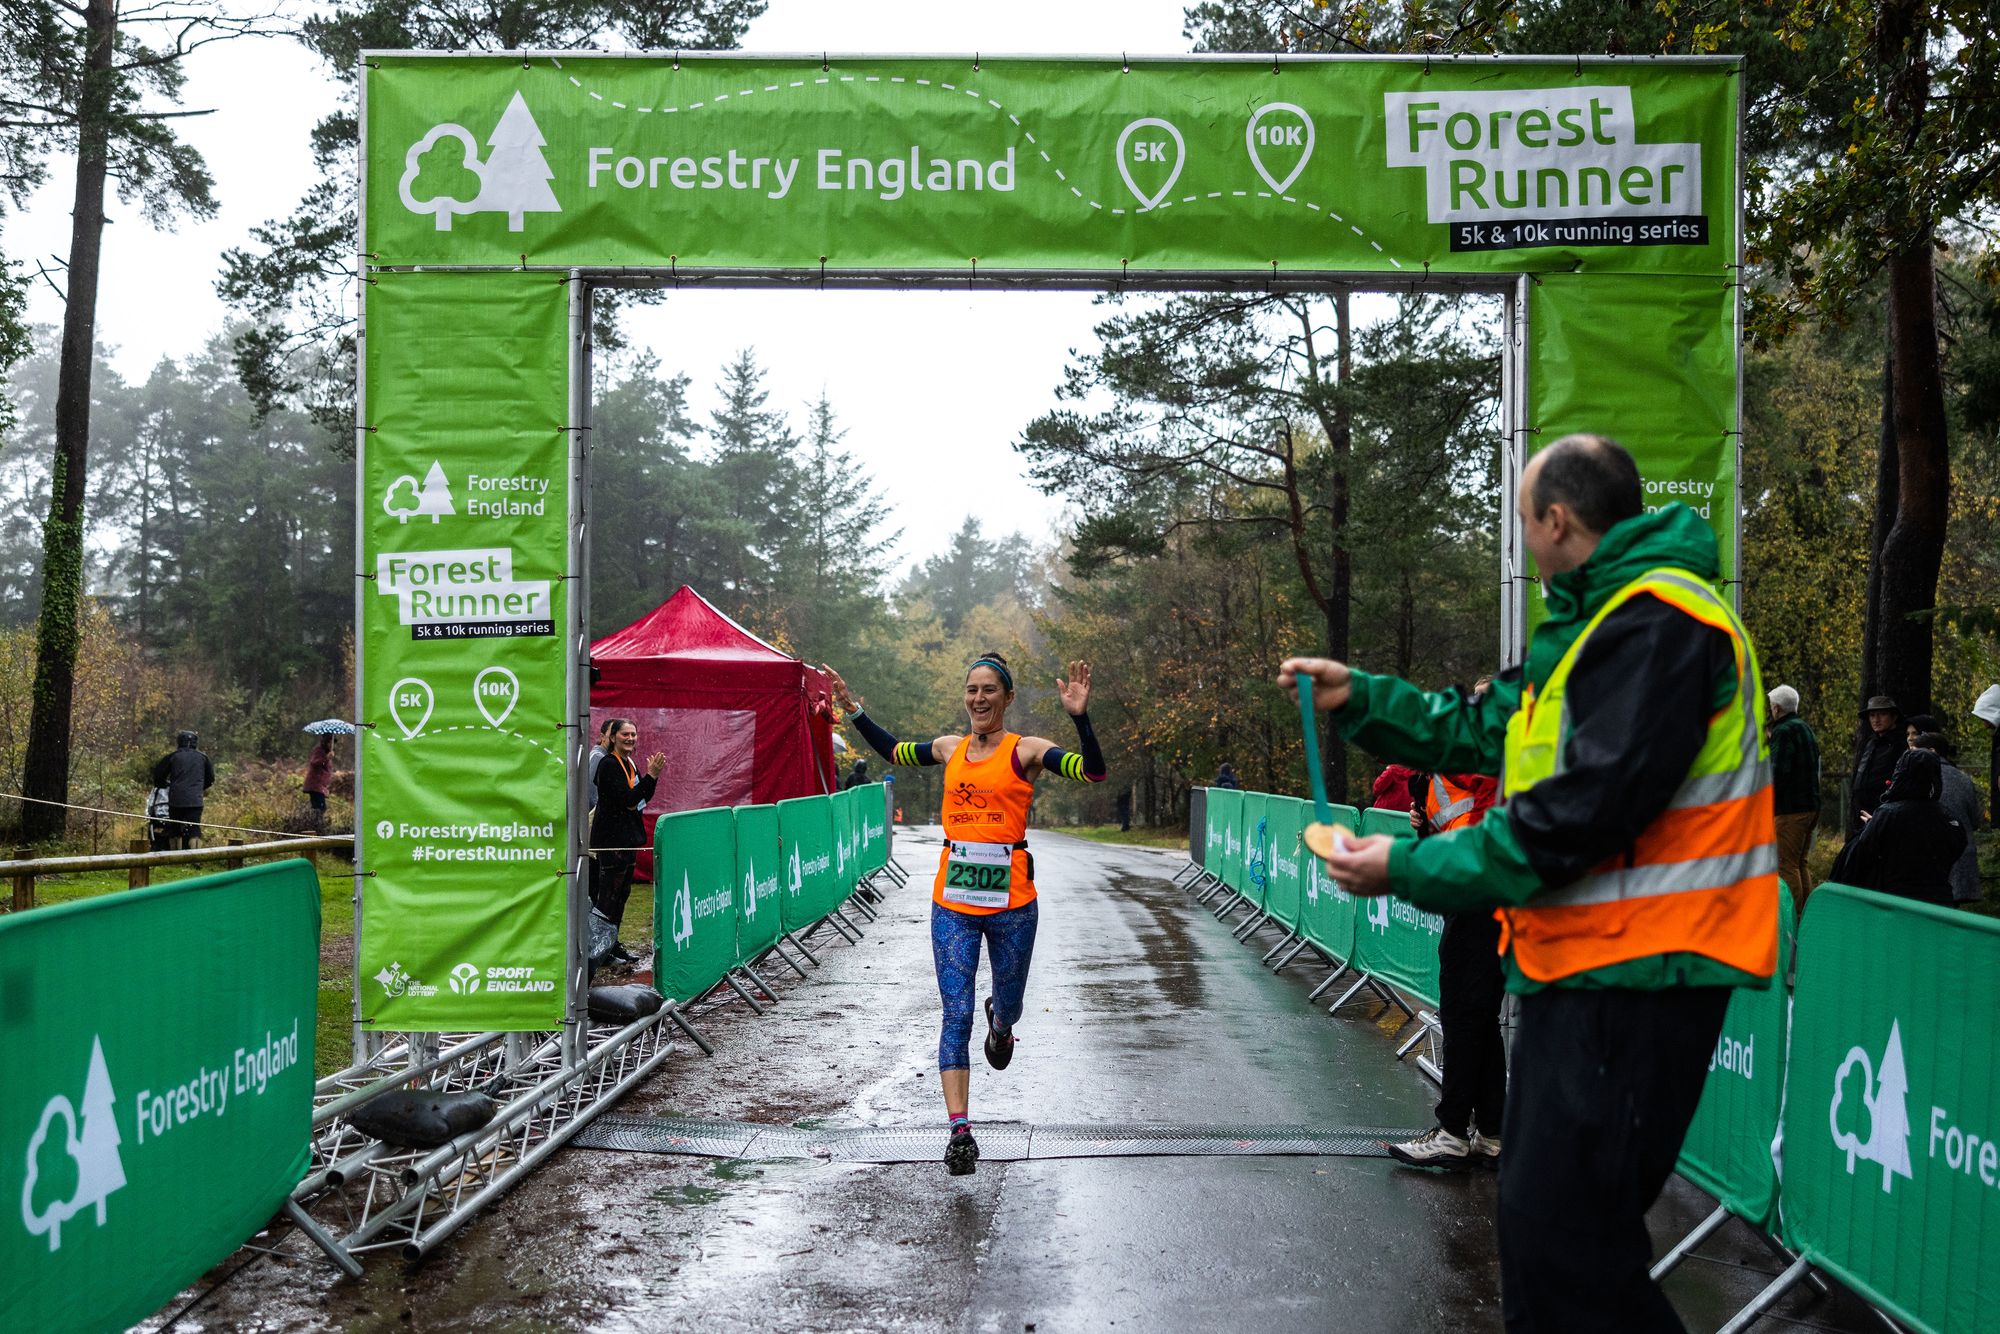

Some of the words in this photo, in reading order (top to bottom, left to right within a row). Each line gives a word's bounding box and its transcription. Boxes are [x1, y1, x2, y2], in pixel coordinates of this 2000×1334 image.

[1256, 124, 1304, 148] 10K
[1407, 97, 1617, 153] Forest
[1133, 141, 1166, 163] 5K
[588, 147, 800, 200] Forestry
[817, 145, 1015, 201] England
[1450, 158, 1684, 211] Runner
[1459, 223, 1486, 245] 5k
[1490, 223, 1506, 245] &
[1512, 221, 1550, 245] 10k
[1555, 221, 1634, 245] running
[1640, 219, 1700, 241] series
[468, 474, 550, 495] Forestry
[468, 498, 545, 520] England
[389, 555, 503, 587] Forest
[411, 590, 540, 619] Runner
[417, 624, 431, 637] 5k
[433, 624, 443, 637] &
[445, 623, 466, 636] 10k
[468, 624, 513, 637] running
[515, 622, 550, 634] series
[400, 692, 422, 708] 5K
[480, 681, 511, 697] 10K
[400, 822, 554, 842] ForestryEngland
[412, 844, 555, 862] #ForestRunner
[949, 863, 1006, 890] 2302
[694, 893, 716, 920] Forestry
[715, 883, 733, 914] England
[1391, 895, 1420, 931] Forestry
[1420, 911, 1444, 936] Englan
[487, 967, 534, 979] SPORT
[487, 980, 555, 992] ENGLAND
[137, 1064, 229, 1145] Forestry
[234, 1017, 298, 1095] England
[1928, 1105, 2000, 1191] Fore
